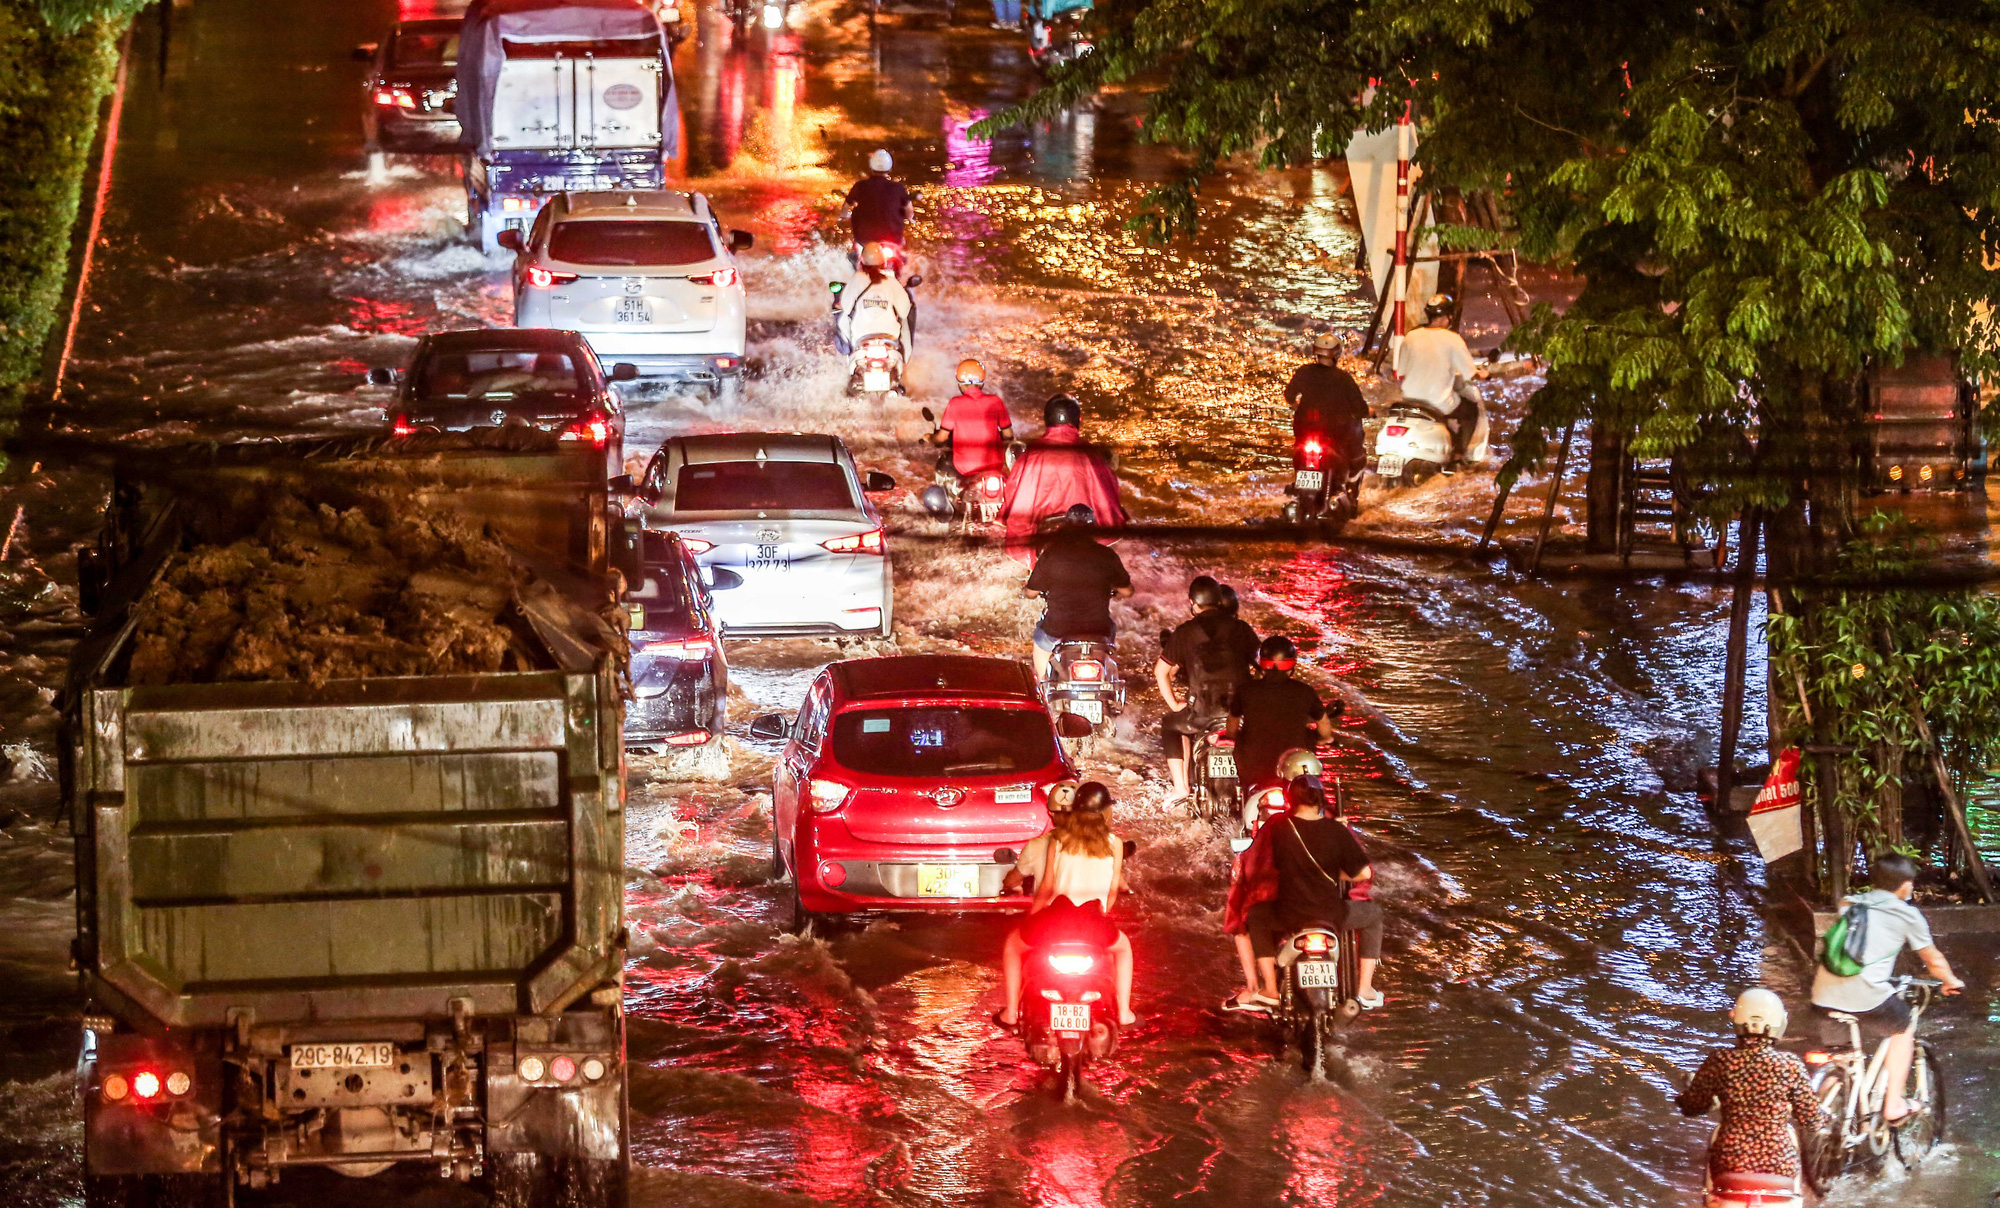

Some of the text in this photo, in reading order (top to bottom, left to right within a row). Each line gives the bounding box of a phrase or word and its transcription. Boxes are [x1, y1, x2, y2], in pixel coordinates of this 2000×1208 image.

[624, 300, 643, 311] 51H
[617, 311, 650, 322] 361.54
[757, 545, 778, 559] 30F
[1213, 756, 1236, 766] 29-V
[1779, 780, 1800, 799] 500
[1303, 963, 1331, 975] 29-X1
[1301, 974, 1336, 986] 886.46
[1057, 1005, 1084, 1017] 18-B2
[1053, 1017, 1088, 1029] 048.00
[294, 1045, 391, 1067] 29C-842.19
